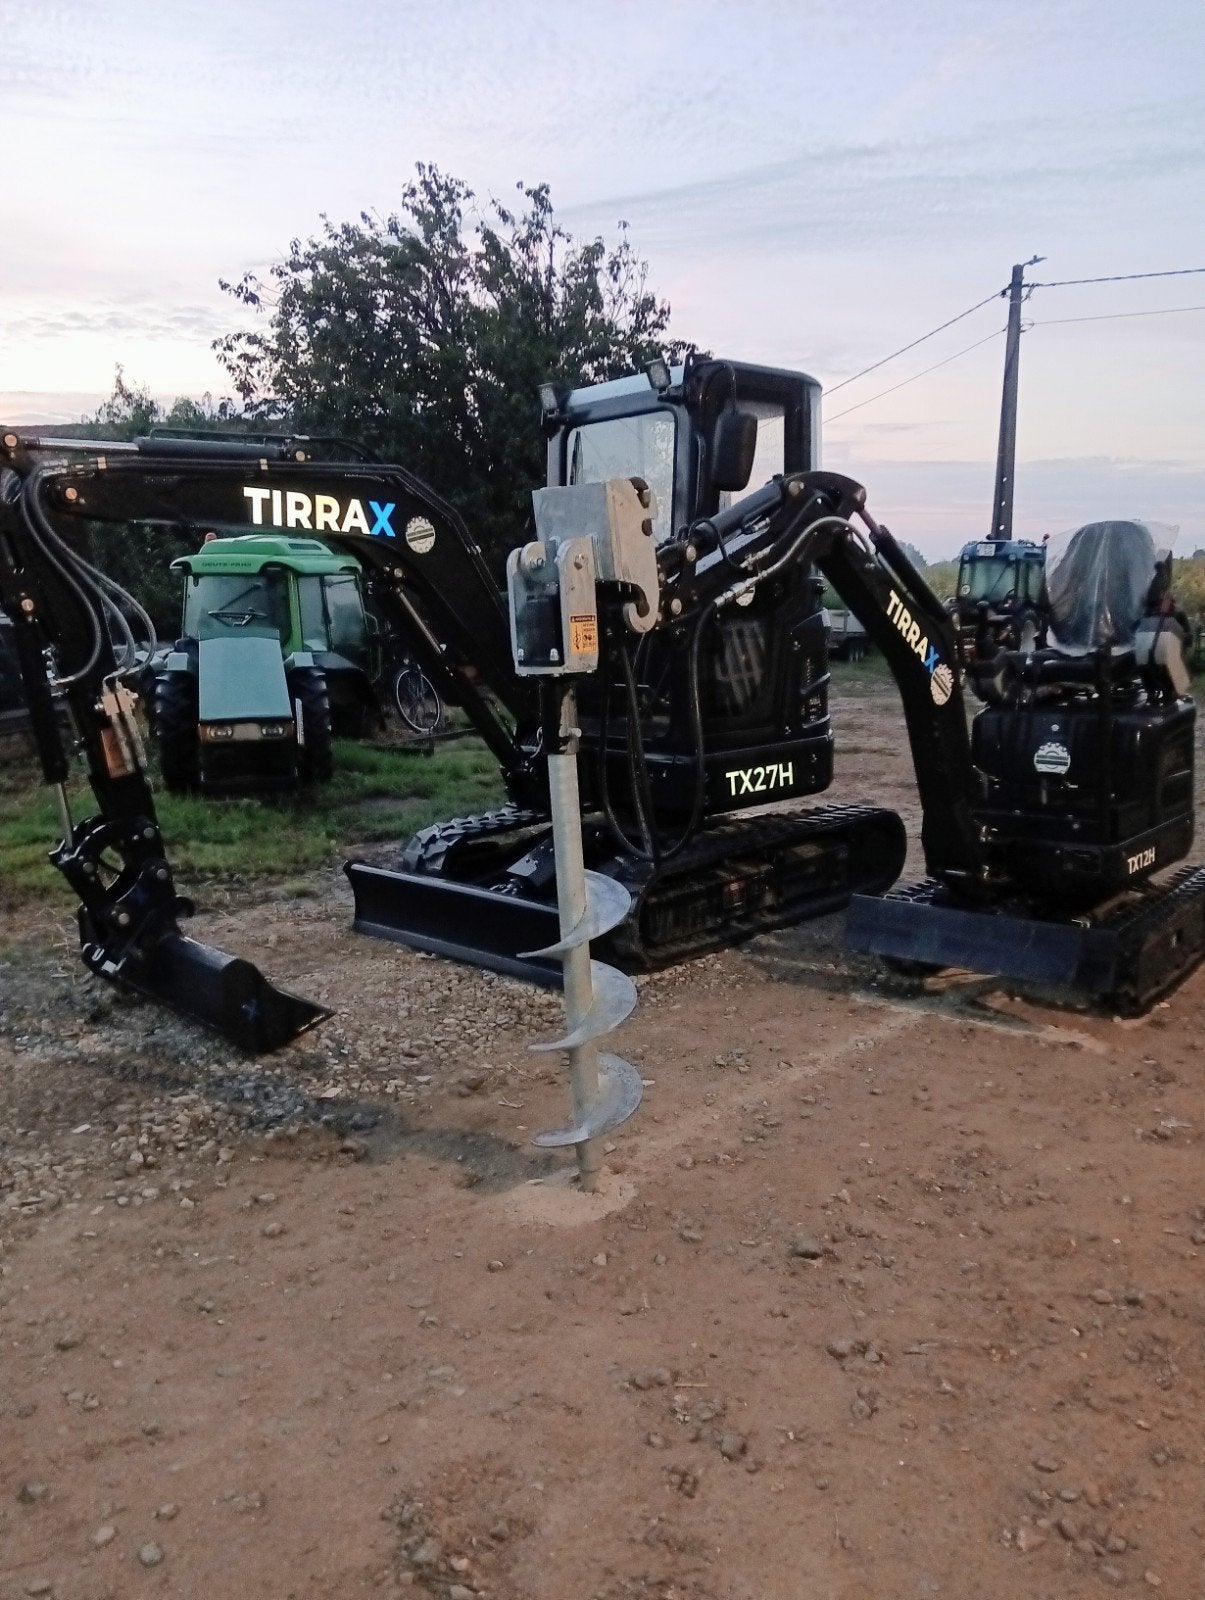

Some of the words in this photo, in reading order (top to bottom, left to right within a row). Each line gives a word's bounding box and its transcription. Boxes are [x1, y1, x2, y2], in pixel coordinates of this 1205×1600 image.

[243, 486, 396, 537] TIRRAX
[886, 589, 940, 674] TIRRAX
[725, 761, 793, 796] TX27H
[1127, 846, 1155, 874] TX12H
